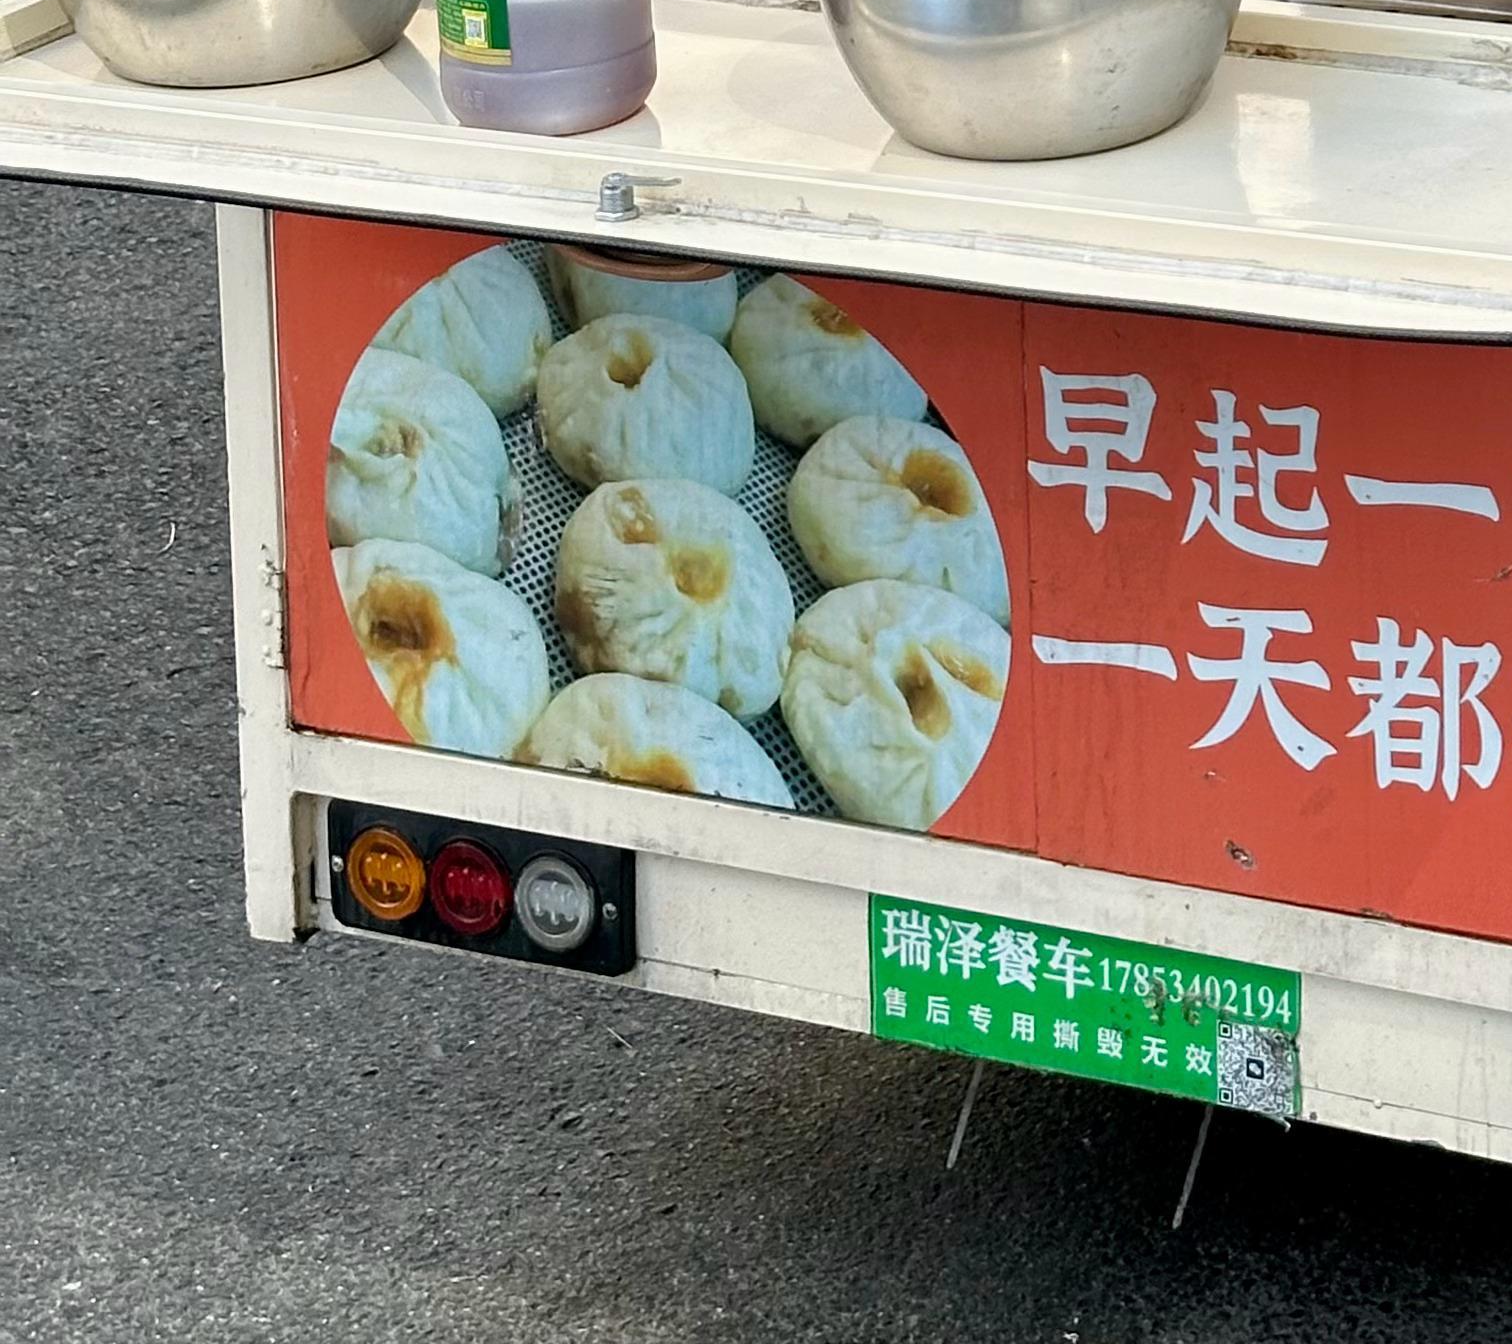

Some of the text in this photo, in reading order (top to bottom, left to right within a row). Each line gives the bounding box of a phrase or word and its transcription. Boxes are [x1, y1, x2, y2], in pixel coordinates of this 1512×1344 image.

[881, 908, 1095, 999] 瑞泽餐车
[882, 986, 1213, 1077] 售后专用撕毁无效
